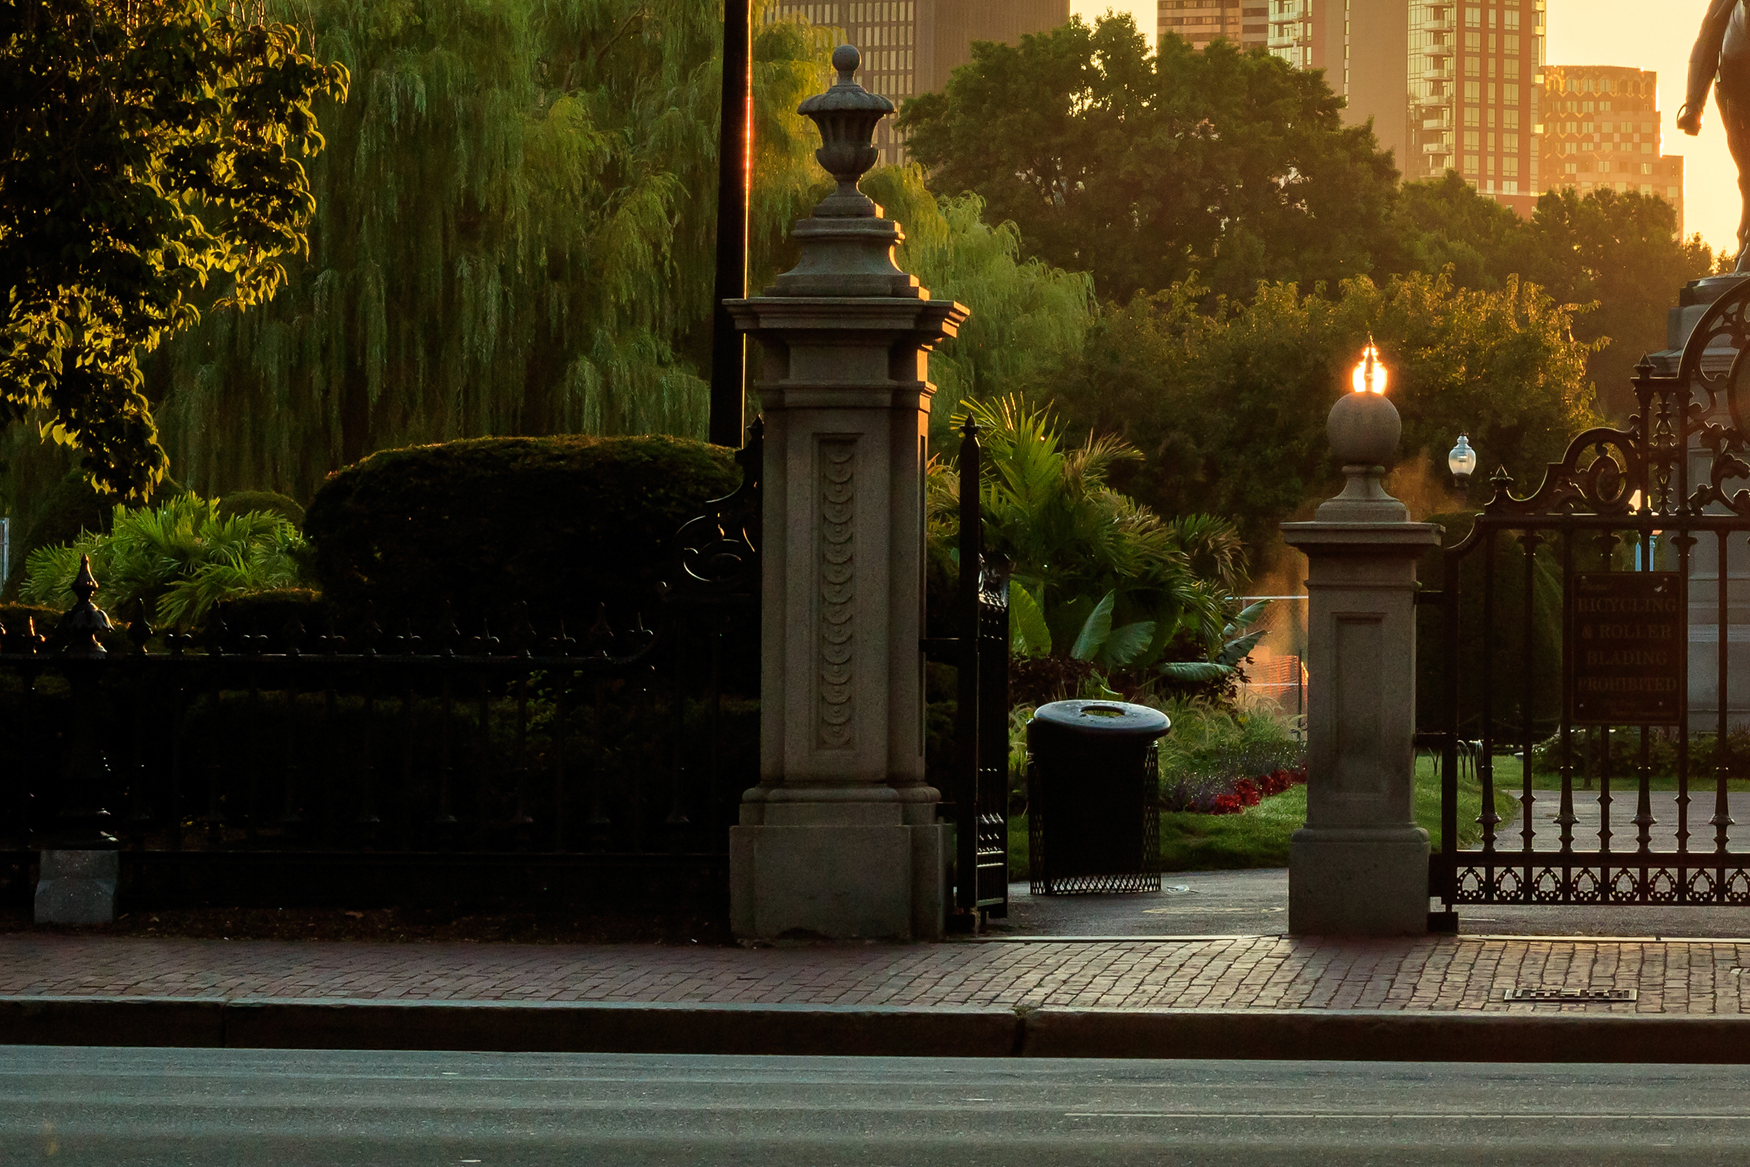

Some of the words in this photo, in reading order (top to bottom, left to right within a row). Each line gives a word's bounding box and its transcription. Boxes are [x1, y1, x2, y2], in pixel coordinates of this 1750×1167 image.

[1577, 597, 1676, 612] BICYCLING
[1581, 625, 1593, 639] &
[1599, 624, 1672, 639] ROLLER
[1586, 650, 1668, 665] BLADING
[1577, 677, 1677, 691] PROHIBITED
